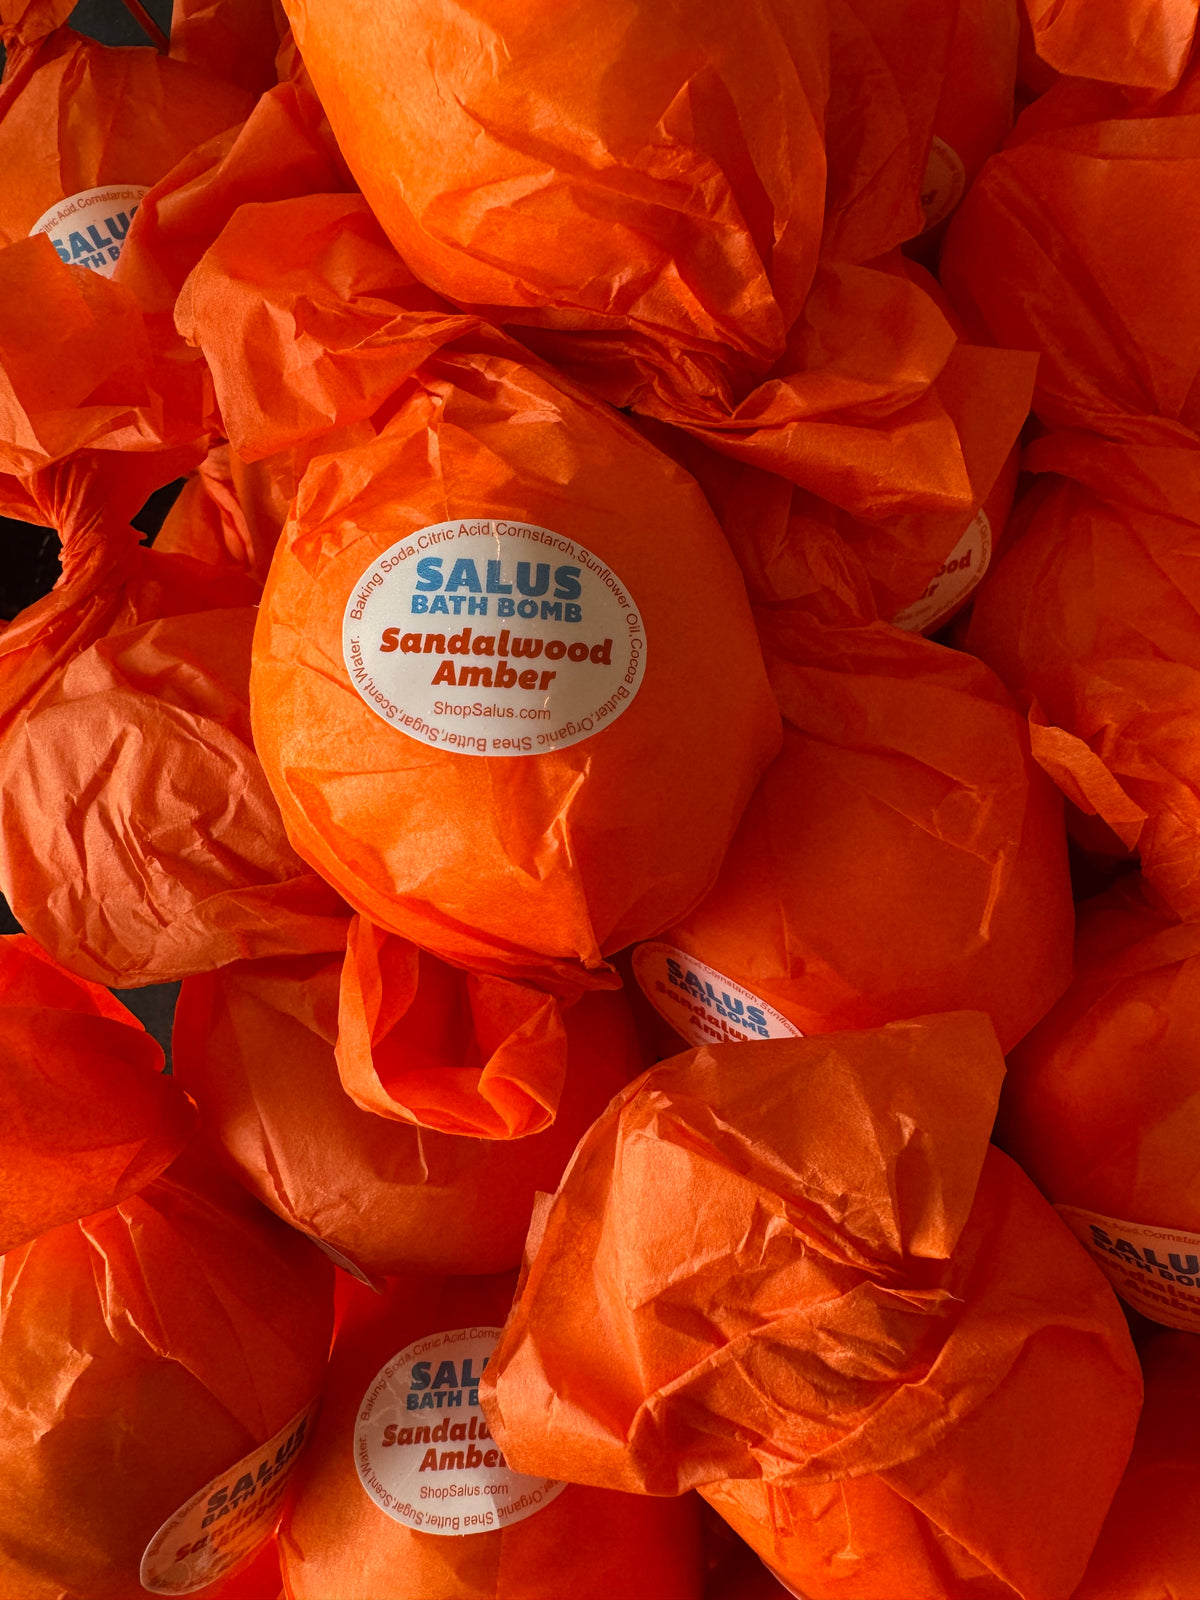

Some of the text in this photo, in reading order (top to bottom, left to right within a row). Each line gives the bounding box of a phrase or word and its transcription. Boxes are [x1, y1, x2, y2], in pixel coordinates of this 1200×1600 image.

[52, 205, 140, 264] SALU
[415, 556, 582, 600] SALUS
[410, 594, 582, 623] BATH BOMB
[350, 572, 384, 621] Baking
[492, 736, 533, 751] Shea
[379, 627, 613, 665] Sandalwood
[431, 660, 556, 691] Amber
[433, 701, 551, 720] ShopSalus.com
[666, 958, 767, 1026] SALUS
[668, 972, 770, 1038] BATH BOMB
[1089, 1224, 1200, 1275] SALU
[406, 1389, 462, 1411] BATH
[420, 1483, 508, 1501] ShopSalus.com
[463, 1511, 494, 1527] Shea
